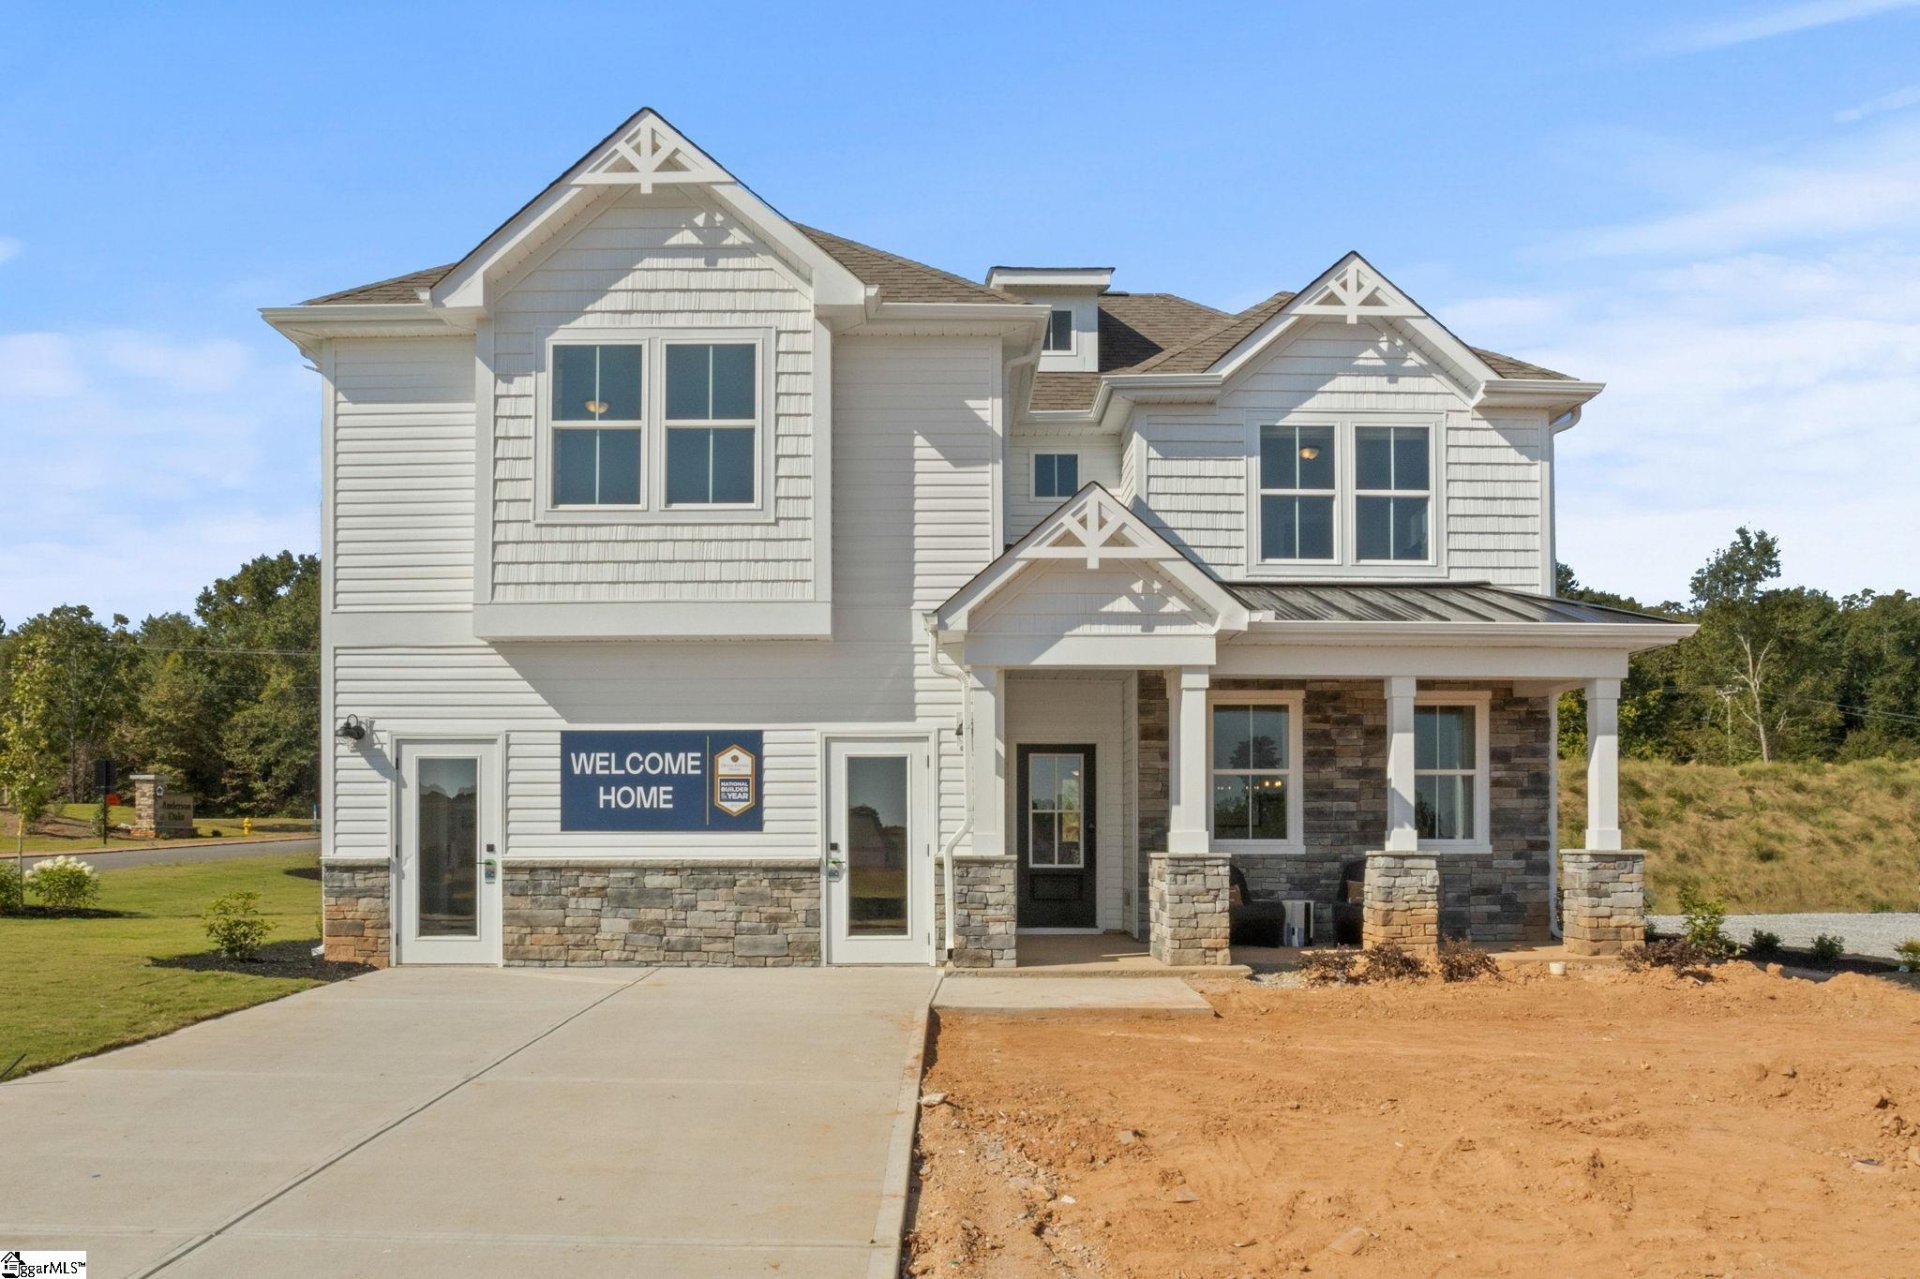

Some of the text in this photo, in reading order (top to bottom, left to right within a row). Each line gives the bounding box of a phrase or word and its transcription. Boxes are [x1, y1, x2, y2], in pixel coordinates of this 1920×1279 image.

[570, 752, 701, 775] WELCOME
[599, 786, 673, 809] HOME
[727, 792, 749, 800] YEAR
